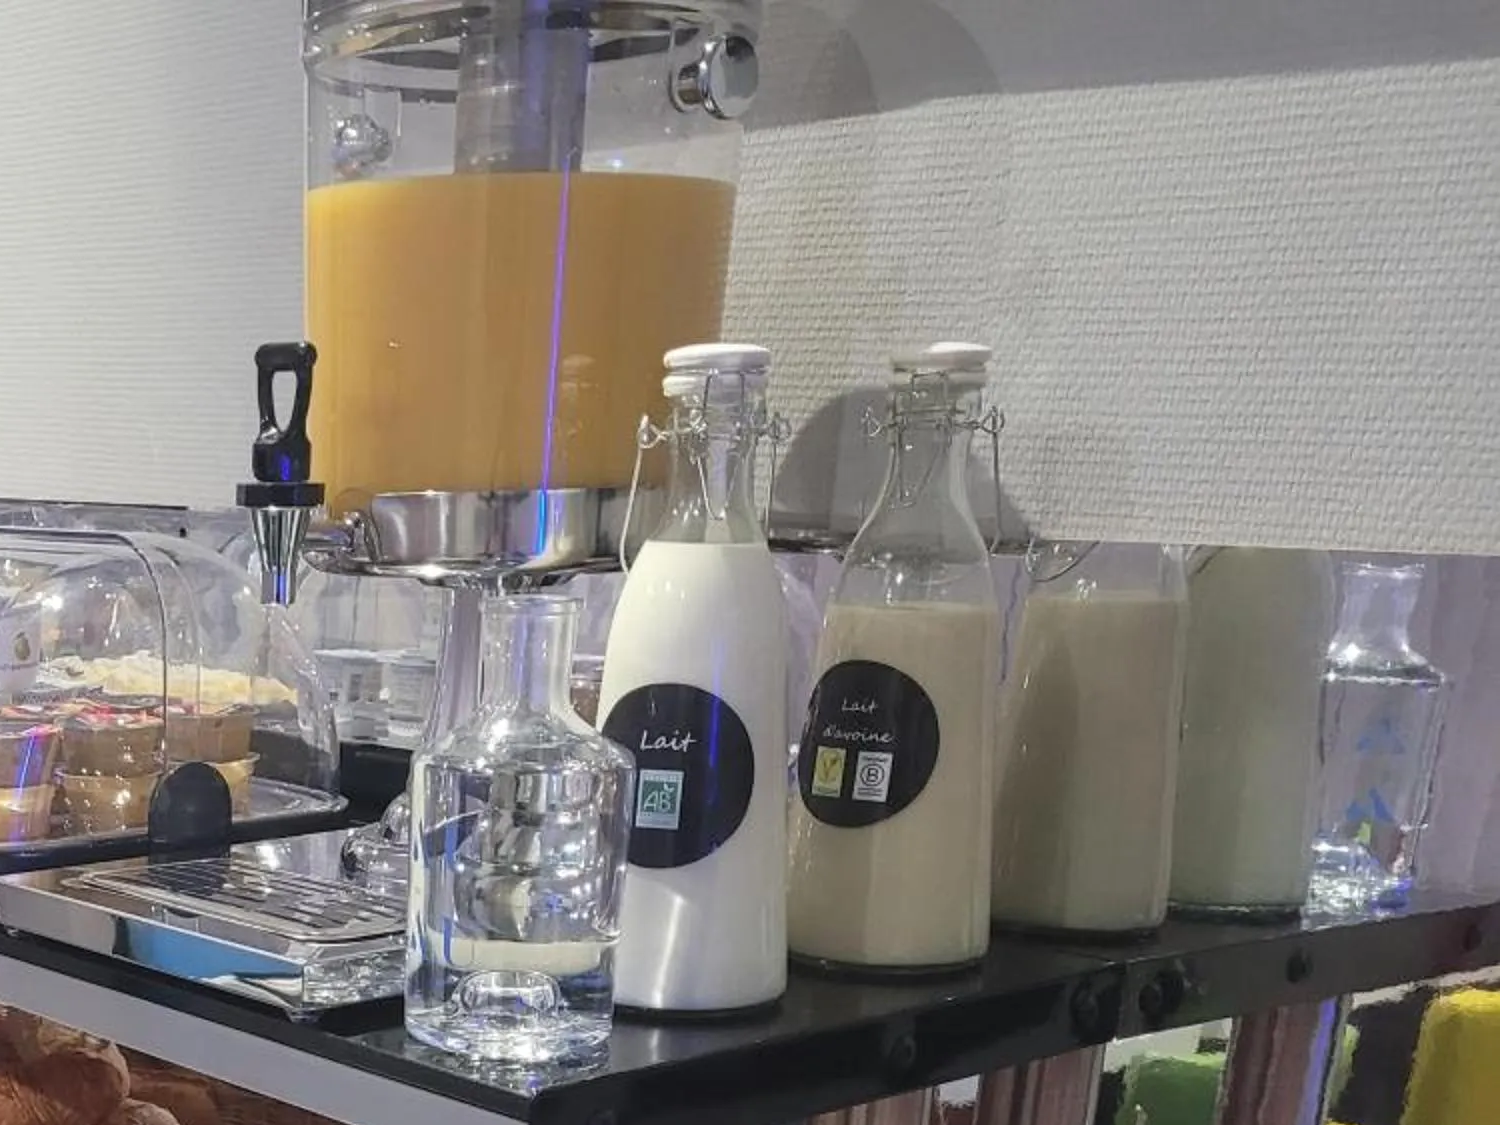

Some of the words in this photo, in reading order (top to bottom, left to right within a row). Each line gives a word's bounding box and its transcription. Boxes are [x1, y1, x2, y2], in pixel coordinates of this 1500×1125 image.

[841, 697, 878, 714] Lait
[639, 729, 697, 753] Lait
[642, 790, 672, 813] AB
